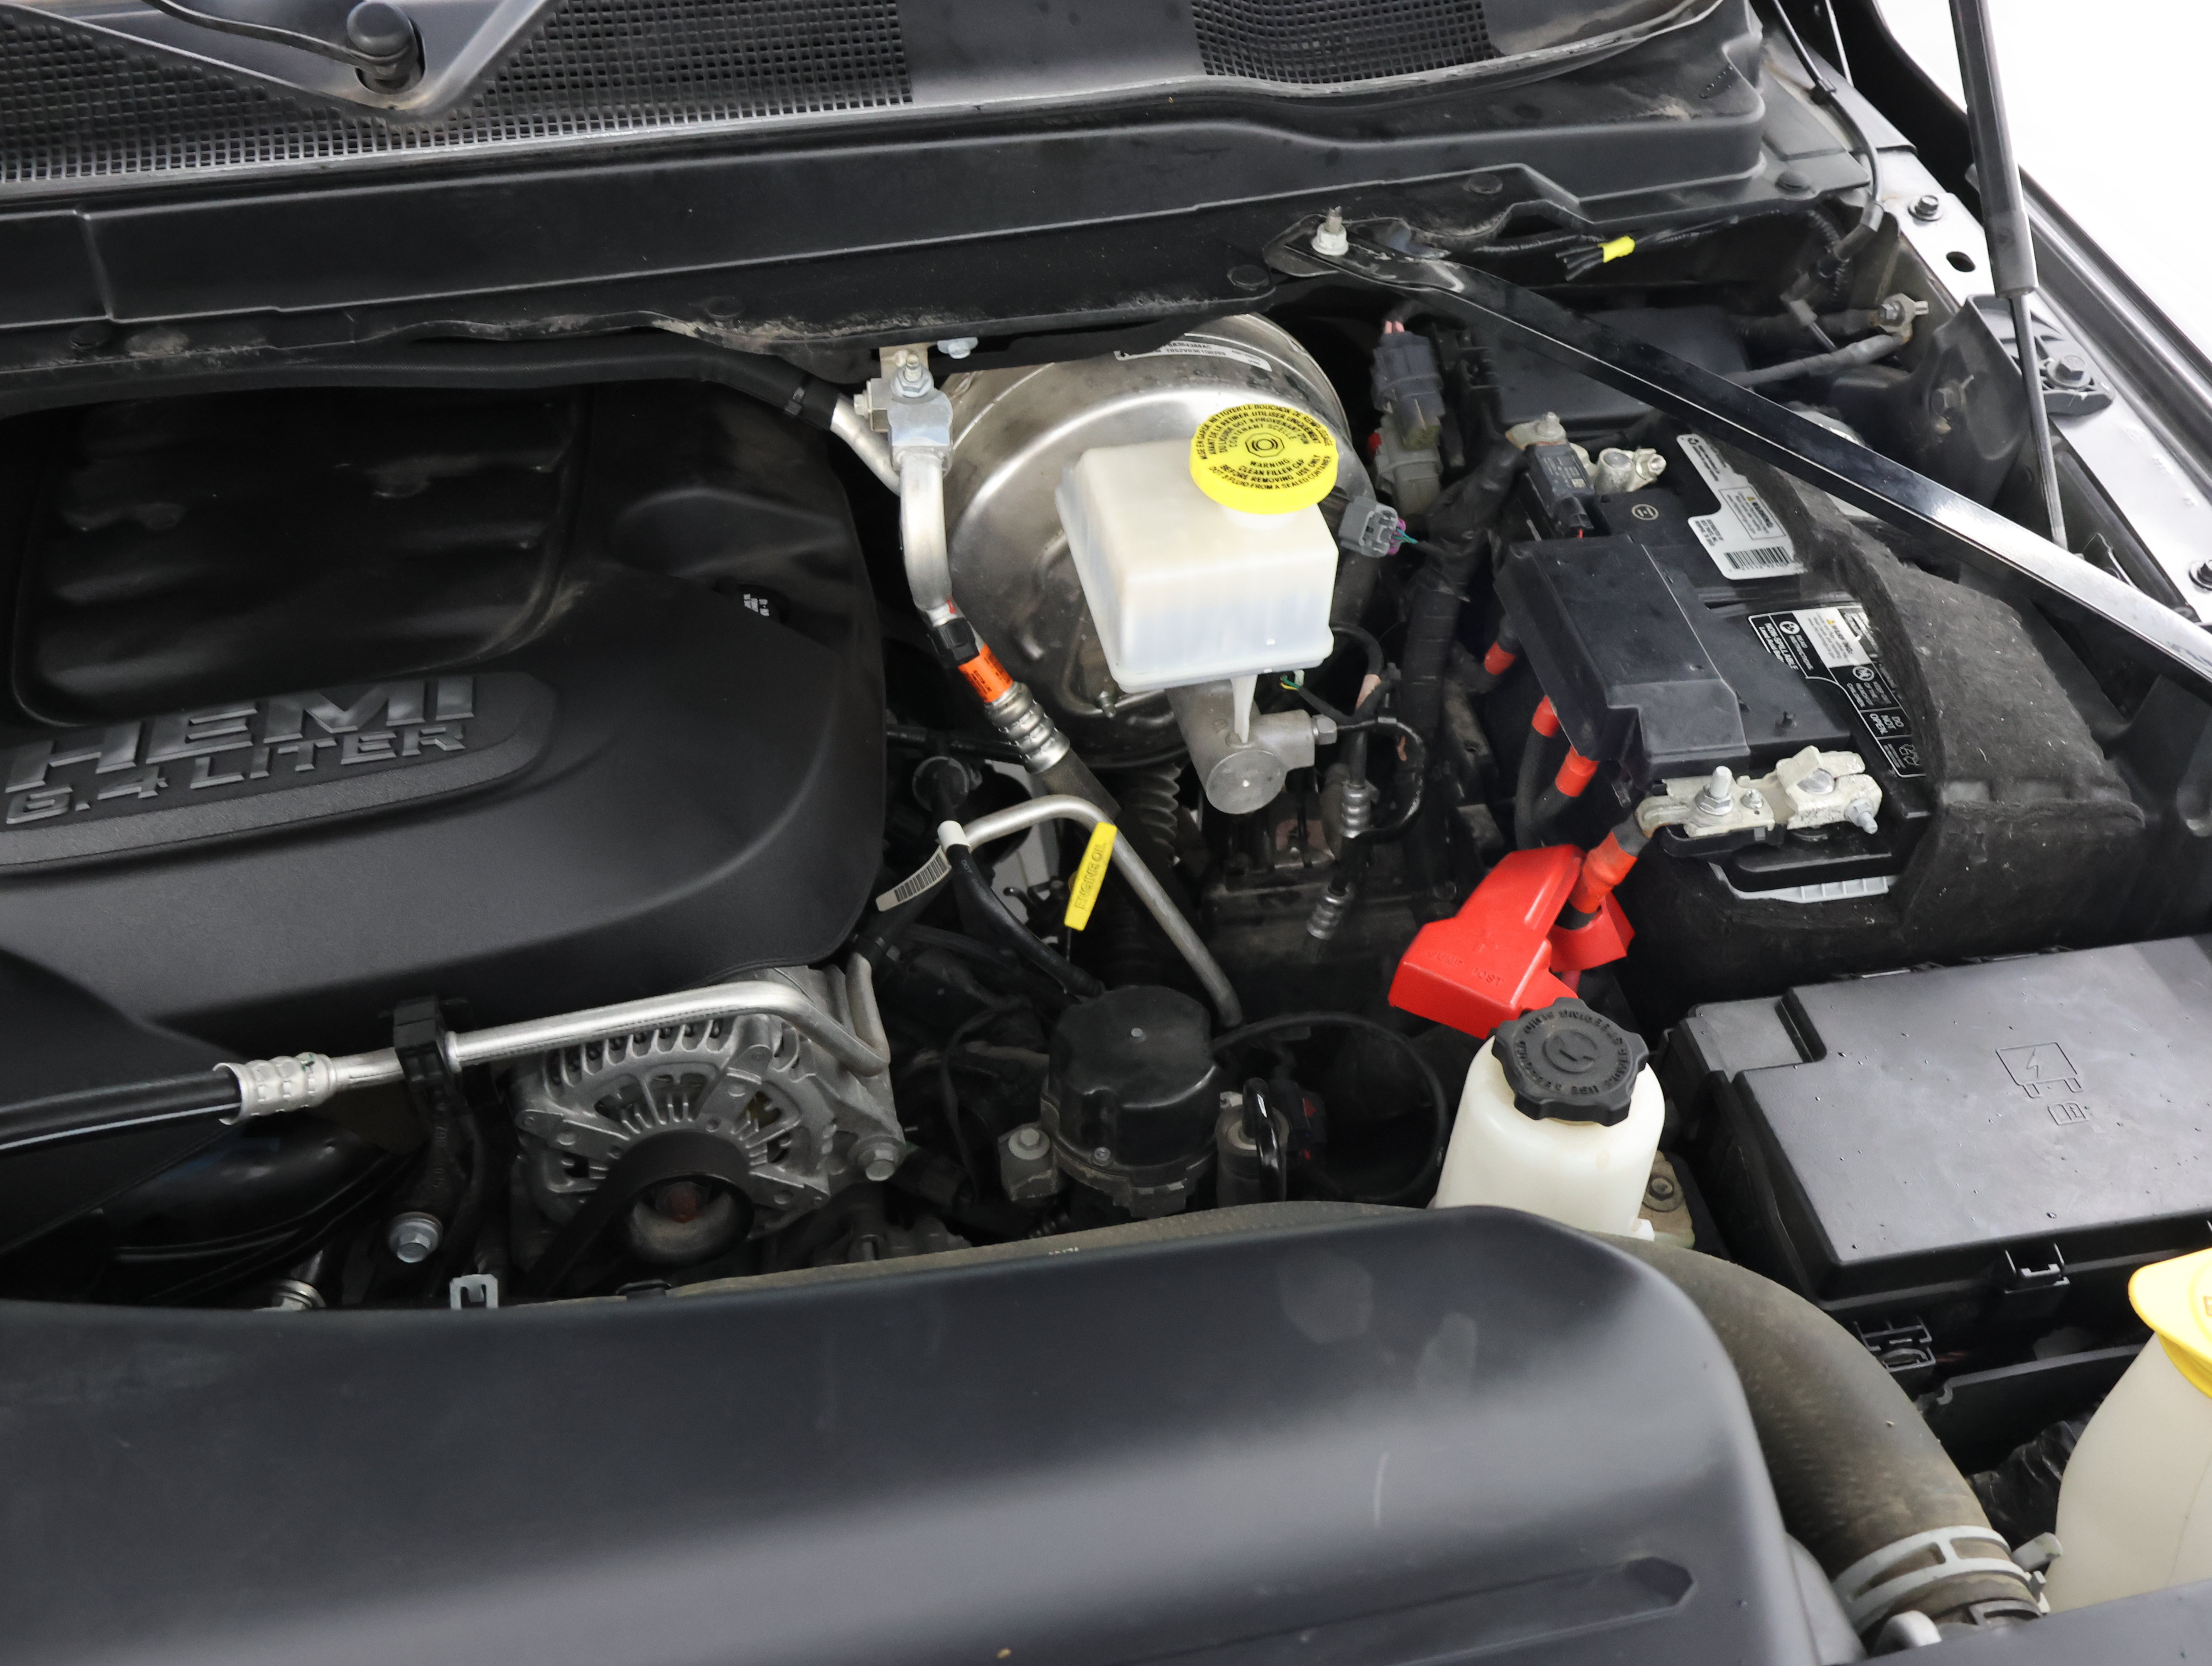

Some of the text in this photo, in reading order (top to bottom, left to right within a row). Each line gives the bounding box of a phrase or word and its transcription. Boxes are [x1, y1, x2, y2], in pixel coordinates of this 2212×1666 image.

[1209, 406, 1242, 423] NETTOYER
[1254, 404, 1290, 413] BOUCHON
[1220, 464, 1248, 479] BEFORE
[1296, 467, 1310, 476] USE
[1239, 459, 1304, 475] CLEAN FILLER CAP
[1209, 466, 1223, 475] DOT
[1228, 477, 1249, 486] FLUID
[1282, 477, 1309, 488] SEALED
[1881, 715, 1896, 730] NOT
[1891, 716, 1904, 727] DO
[5, 676, 477, 791] HEMI
[5, 724, 467, 825] 6.4 LITER
[1075, 841, 1107, 909] ENGINE OIL
[1470, 966, 1505, 986] POST
